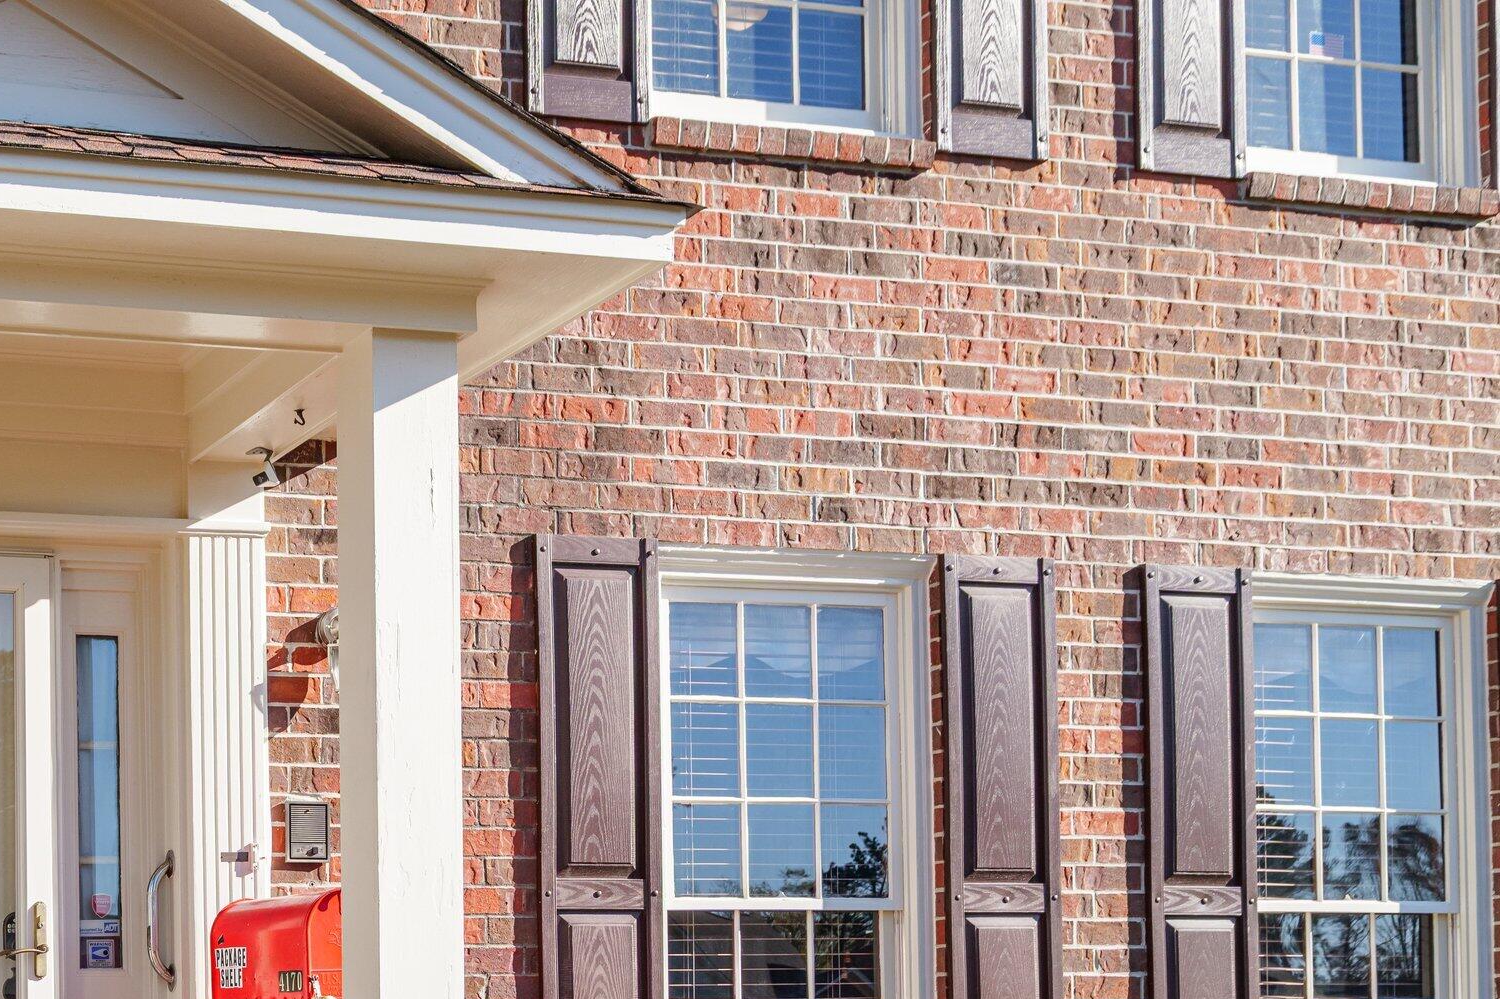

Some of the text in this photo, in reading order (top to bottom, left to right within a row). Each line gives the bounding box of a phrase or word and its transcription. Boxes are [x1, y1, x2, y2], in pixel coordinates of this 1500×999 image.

[105, 924, 118, 932] ADT
[216, 948, 246, 967] PACKAGE
[221, 968, 241, 987] SHELF
[279, 971, 302, 992] 4170
